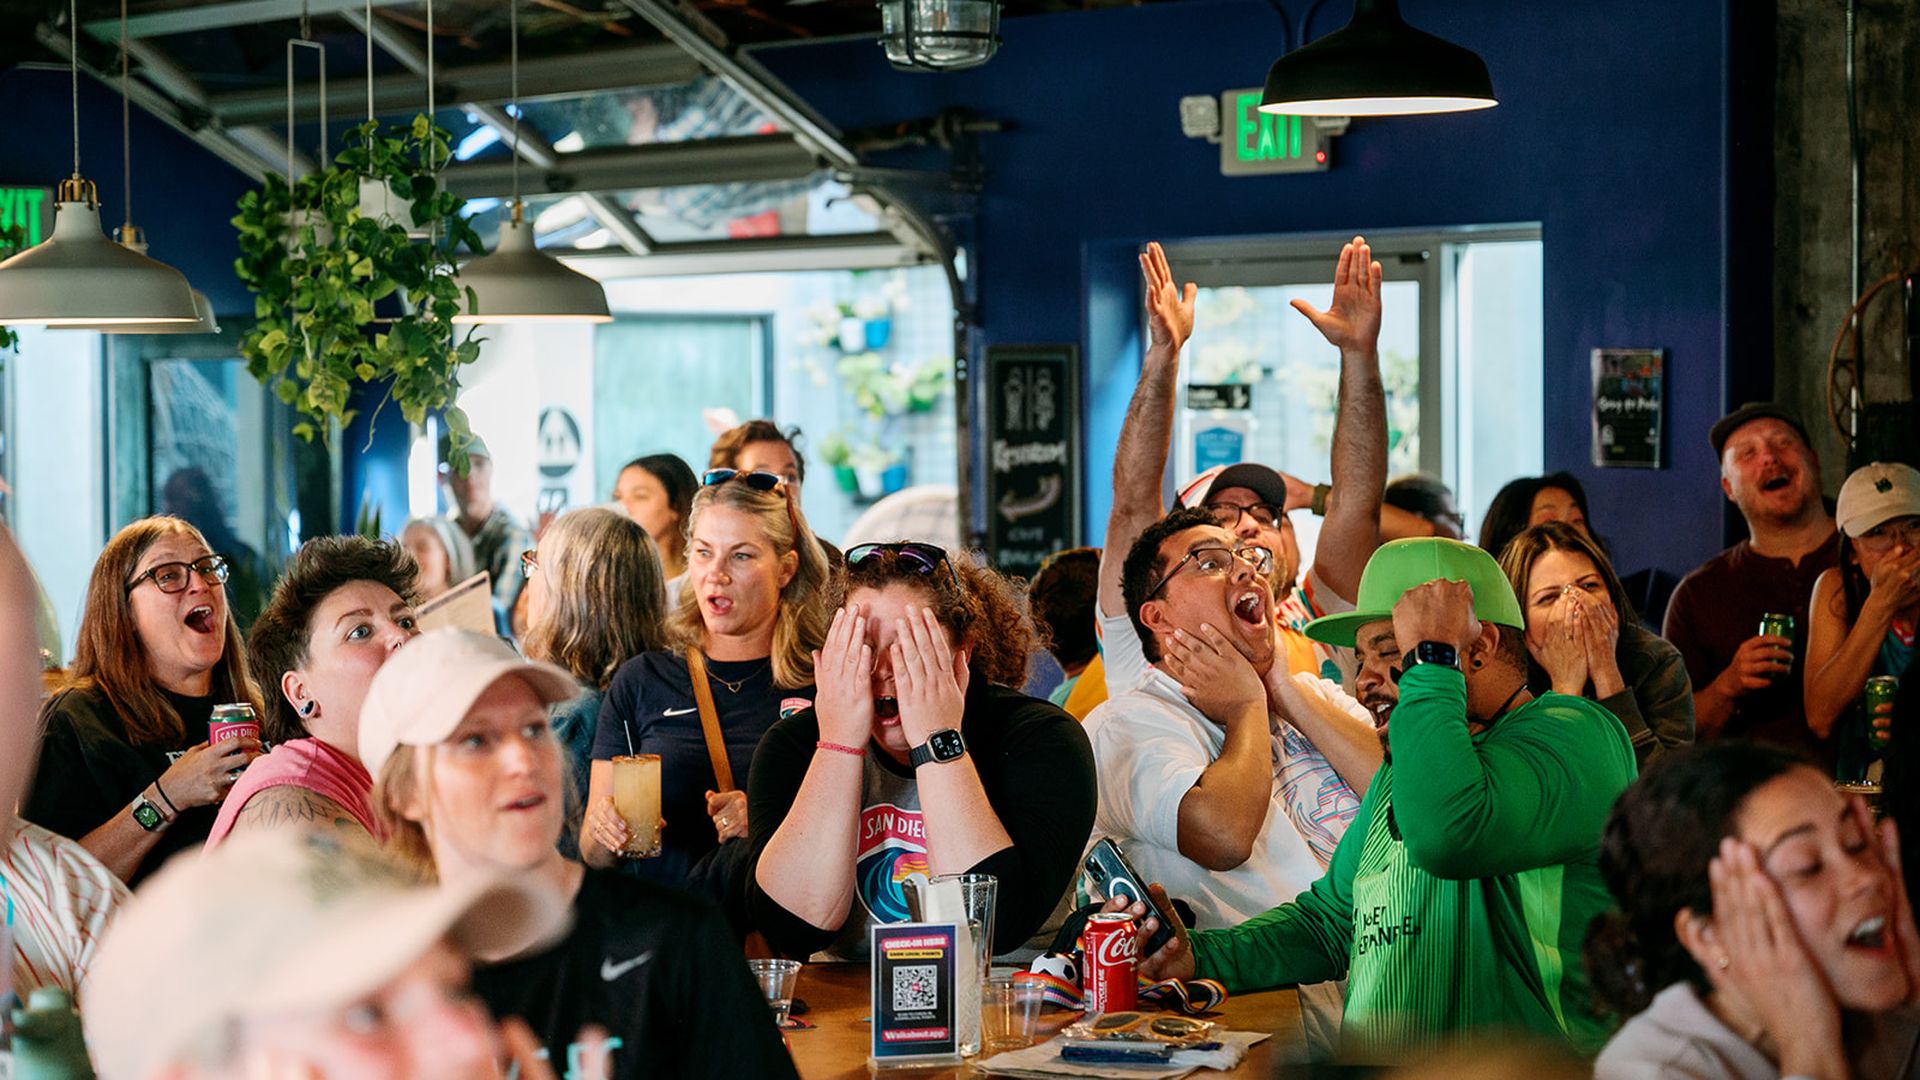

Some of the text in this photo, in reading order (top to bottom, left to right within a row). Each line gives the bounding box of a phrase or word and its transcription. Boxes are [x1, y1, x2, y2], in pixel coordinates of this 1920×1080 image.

[0, 188, 44, 248] XIT
[865, 813, 926, 839] SAN DIE
[1098, 928, 1138, 966] Coc
